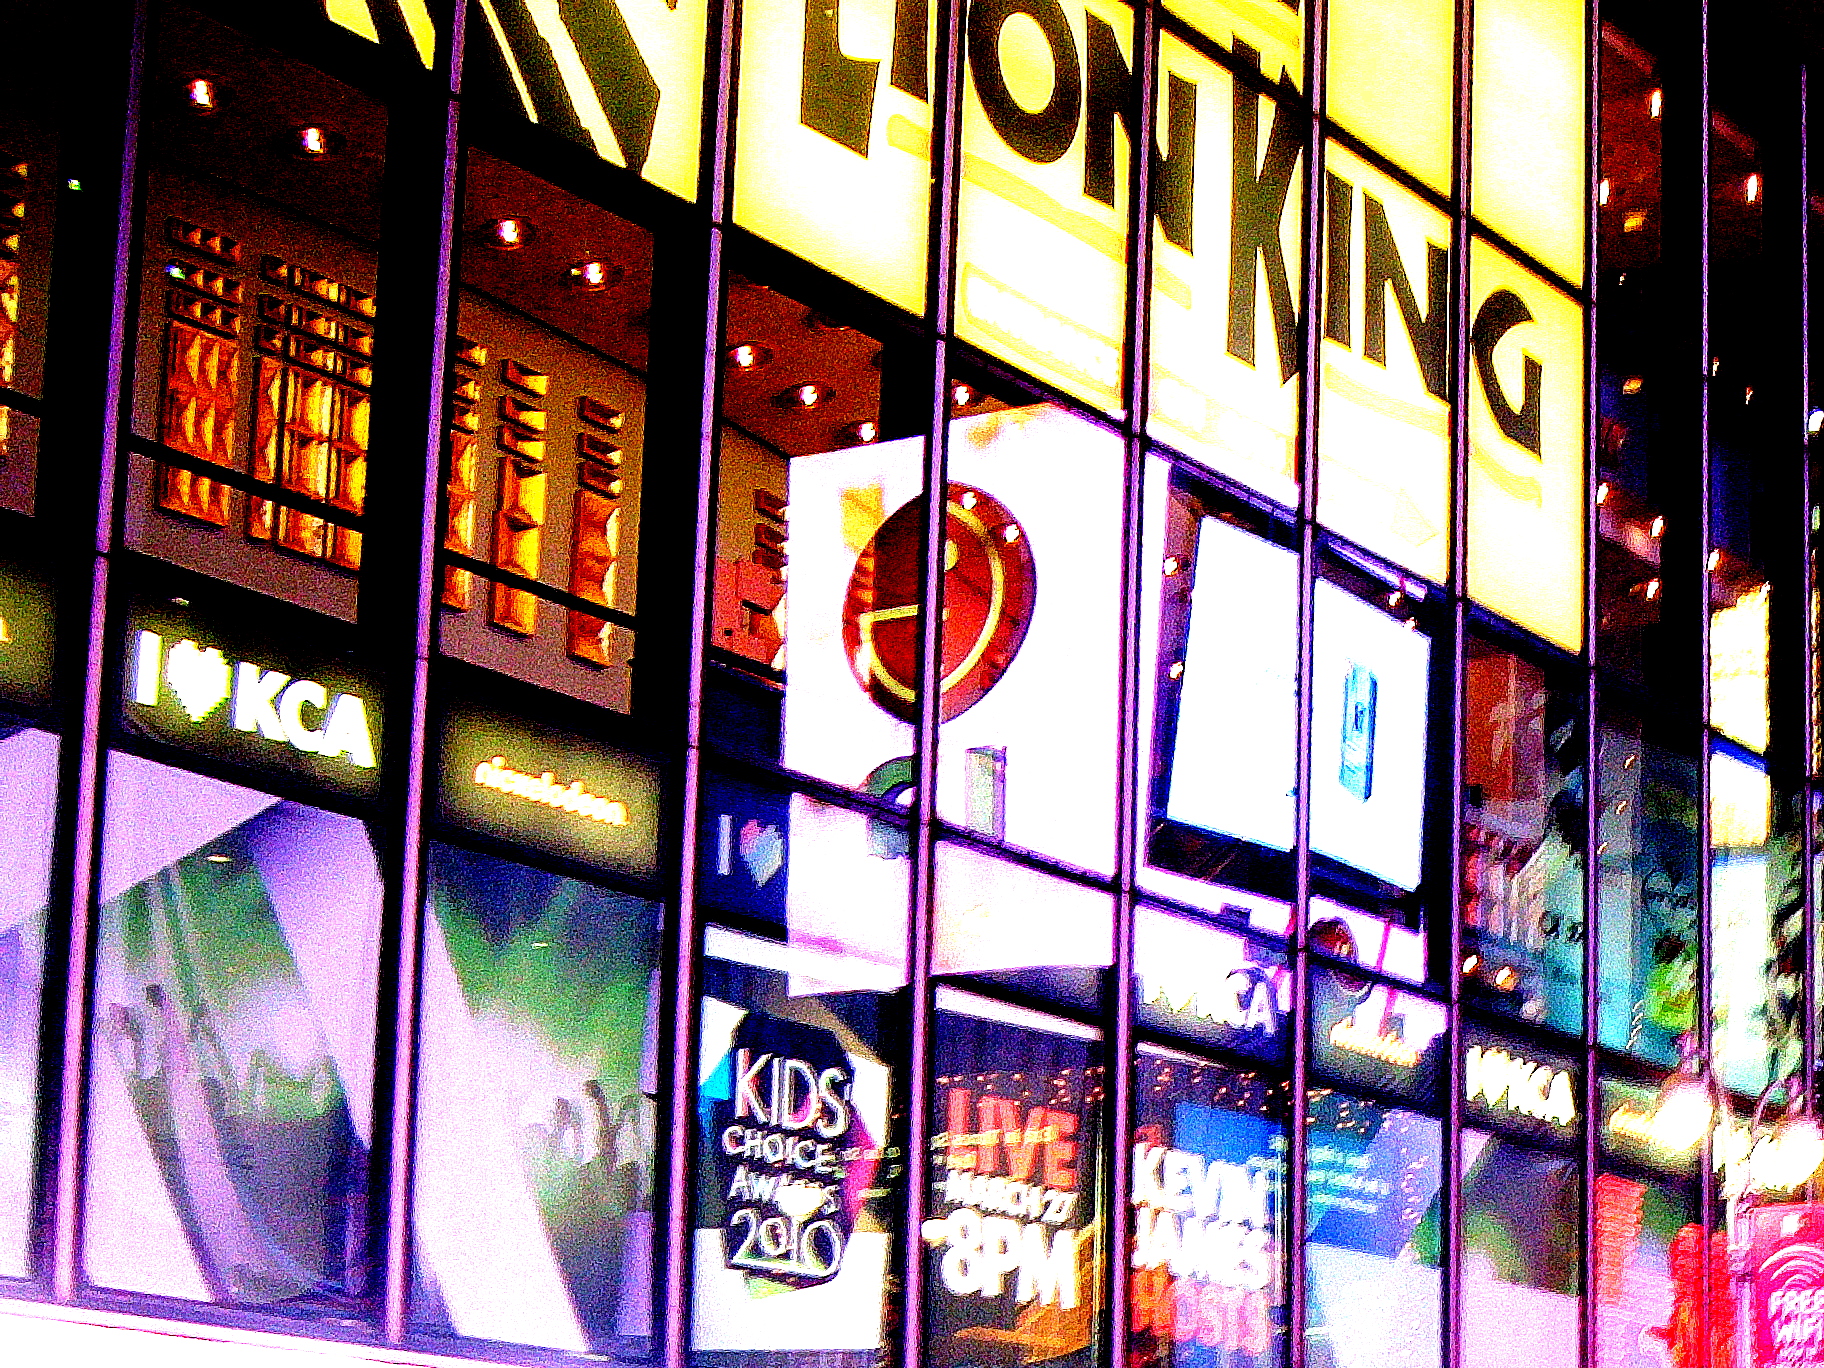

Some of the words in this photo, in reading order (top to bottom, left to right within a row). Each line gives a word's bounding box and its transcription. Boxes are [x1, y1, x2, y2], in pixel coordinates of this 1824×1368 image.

[1227, 33, 1543, 462] KING
[231, 660, 378, 770] KCA
[734, 1048, 853, 1138] KIDS
[722, 1125, 841, 1174] CHOICE
[946, 1088, 1080, 1189] LIVE
[1132, 1143, 1268, 1229] KEVIN
[730, 1208, 842, 1278] 2010
[941, 1207, 1080, 1311] 8PM
[1132, 1206, 1270, 1290] JAMES
